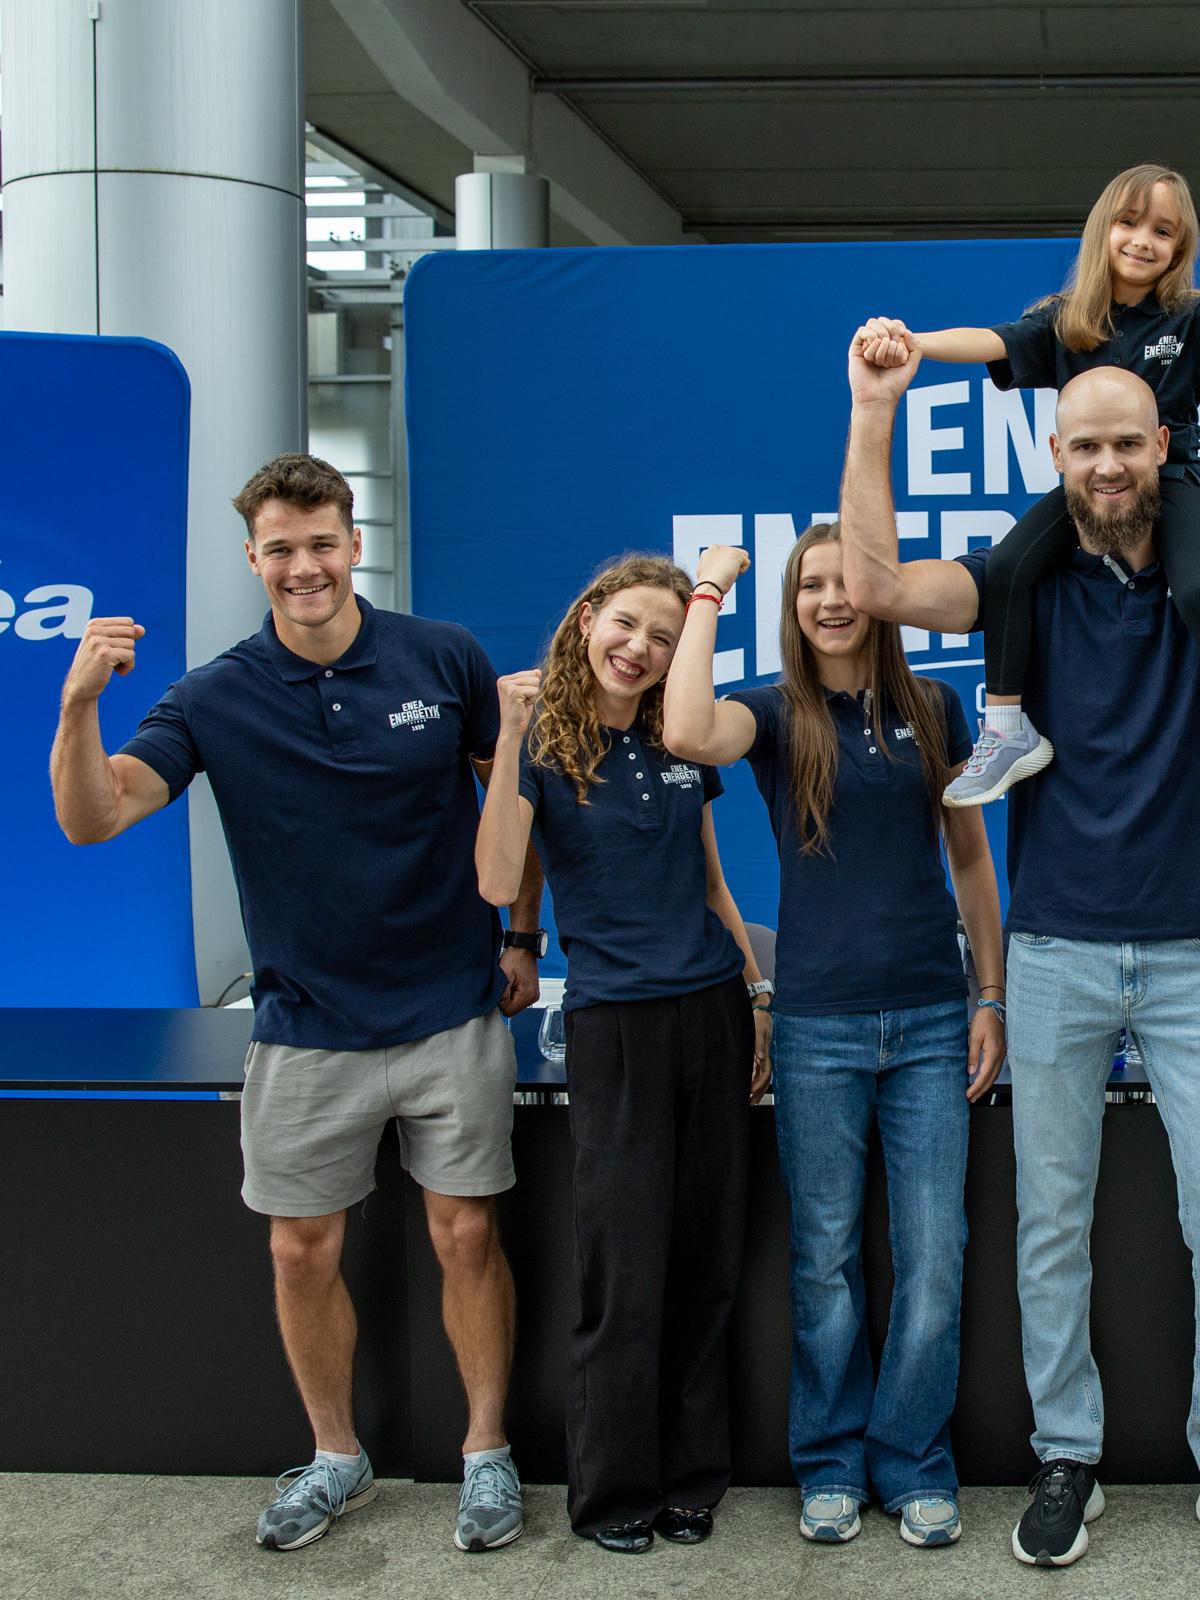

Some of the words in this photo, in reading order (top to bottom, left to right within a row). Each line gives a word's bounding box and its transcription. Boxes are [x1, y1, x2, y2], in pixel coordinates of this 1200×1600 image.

[1159, 335, 1178, 345] ENEA
[402, 700, 425, 712] ENEA
[389, 705, 440, 728] ENERGETYK
[670, 764, 689, 773] ENEA
